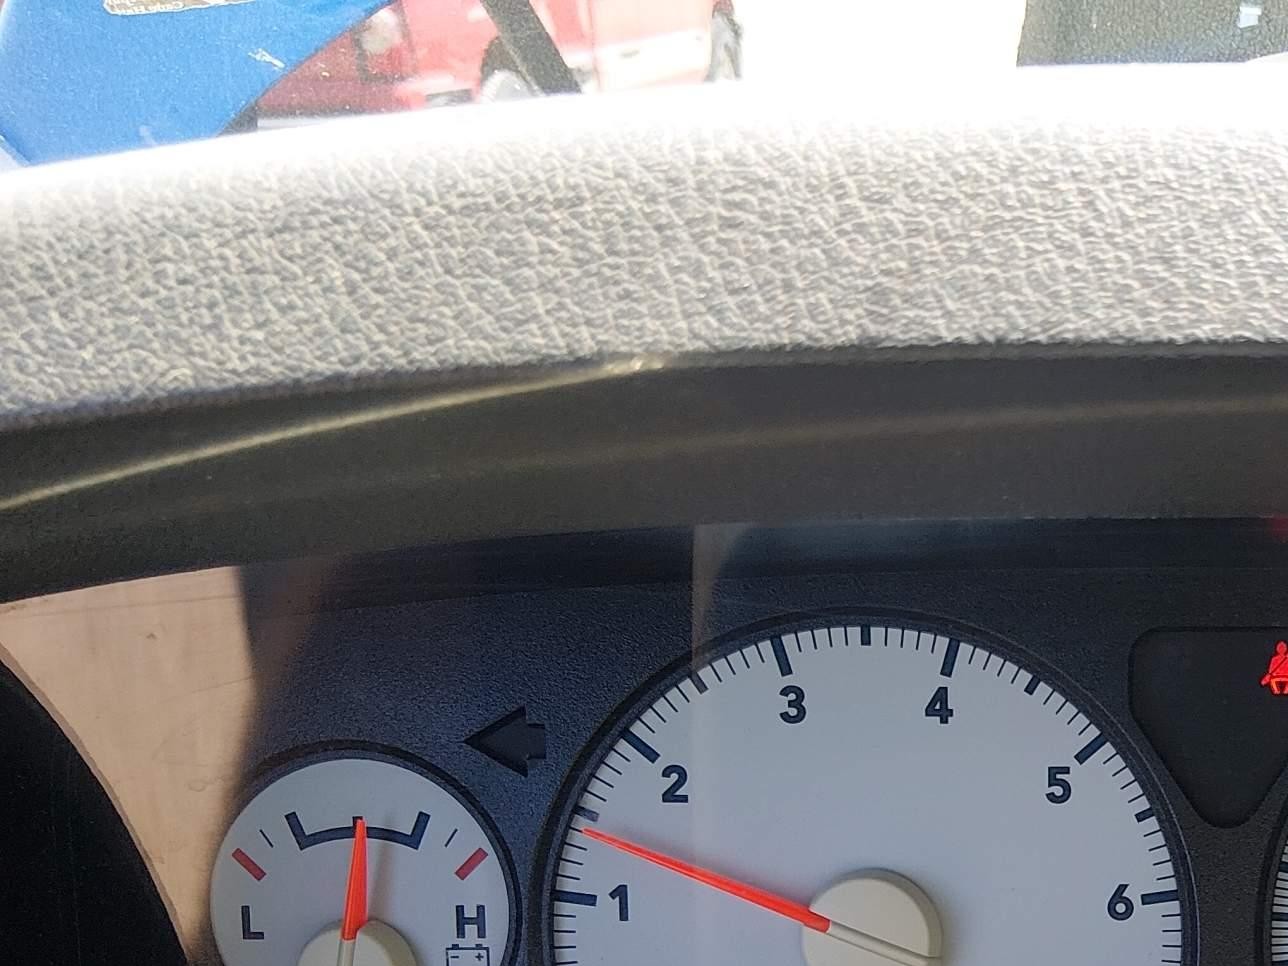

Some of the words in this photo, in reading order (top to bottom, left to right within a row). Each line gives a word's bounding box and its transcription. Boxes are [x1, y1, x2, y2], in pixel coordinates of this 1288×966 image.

[780, 685, 806, 724] 3
[925, 687, 953, 724] 4
[662, 765, 688, 803] 2
[1046, 767, 1071, 804] 5
[609, 885, 628, 921] 1
[1108, 884, 1134, 920] 6
[241, 906, 264, 939] L
[456, 905, 485, 938] H
